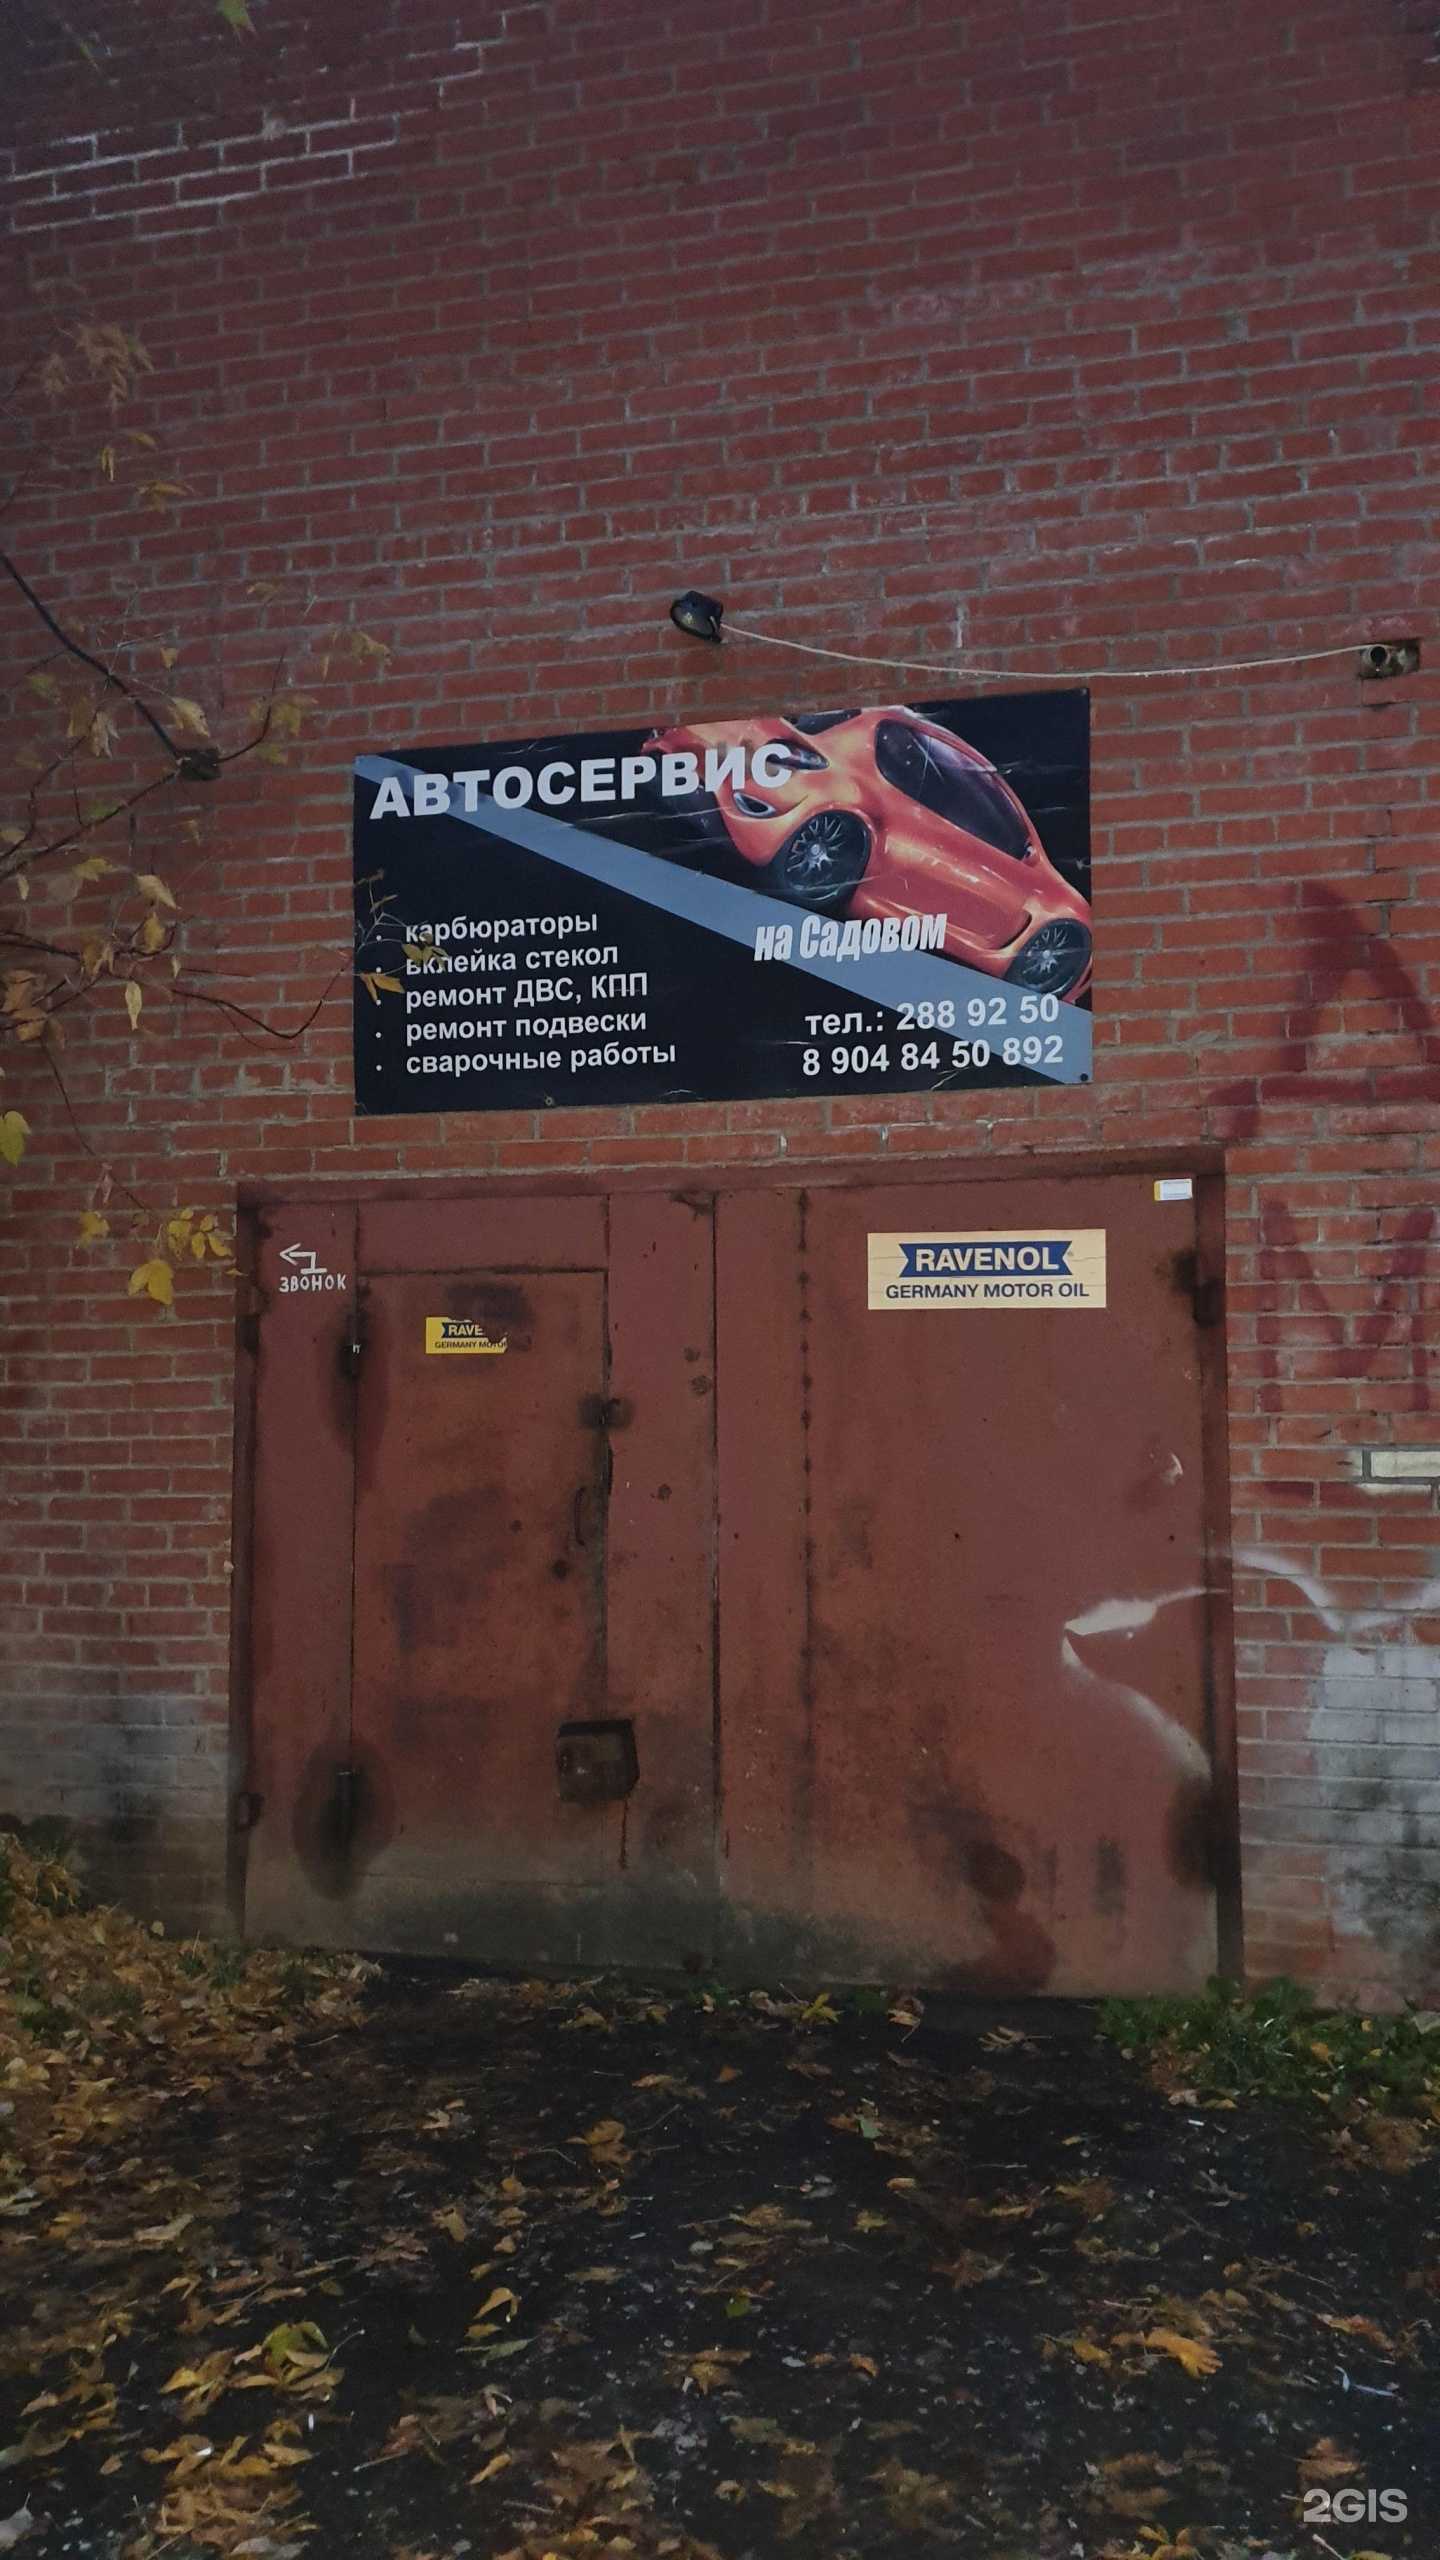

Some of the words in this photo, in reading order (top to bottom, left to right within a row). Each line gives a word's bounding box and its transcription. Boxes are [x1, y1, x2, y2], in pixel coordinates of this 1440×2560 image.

[369, 742, 793, 820] АВТОСЕРВИС
[405, 912, 598, 946] карбюраторы
[753, 924, 793, 962] на
[799, 913, 948, 964] Садовом
[525, 945, 619, 970] стекол
[406, 985, 506, 1014] ремонт
[513, 976, 582, 1007] ДВС,
[591, 972, 648, 999] КПП
[406, 1019, 506, 1046] ремонт
[515, 1011, 647, 1039] подвески
[804, 1010, 884, 1035] тел.:
[896, 1000, 957, 1031] 288
[966, 997, 1008, 1027] 92
[1019, 994, 1060, 1024] 50
[406, 1048, 562, 1077] сварочные
[570, 1042, 676, 1073] работы
[802, 1048, 821, 1076] 8
[831, 1044, 890, 1074] 904
[900, 1042, 941, 1071] 84
[951, 1039, 991, 1068] 50
[1002, 1035, 1064, 1066] 892
[916, 1247, 1060, 1272] RAVENOL
[279, 1274, 347, 1293] ЗВОНОК
[885, 1284, 979, 1299] GERMANY
[983, 1283, 1053, 1298] MOTOR
[1058, 1282, 1090, 1298] OIL
[434, 1340, 478, 1349] GERMANY
